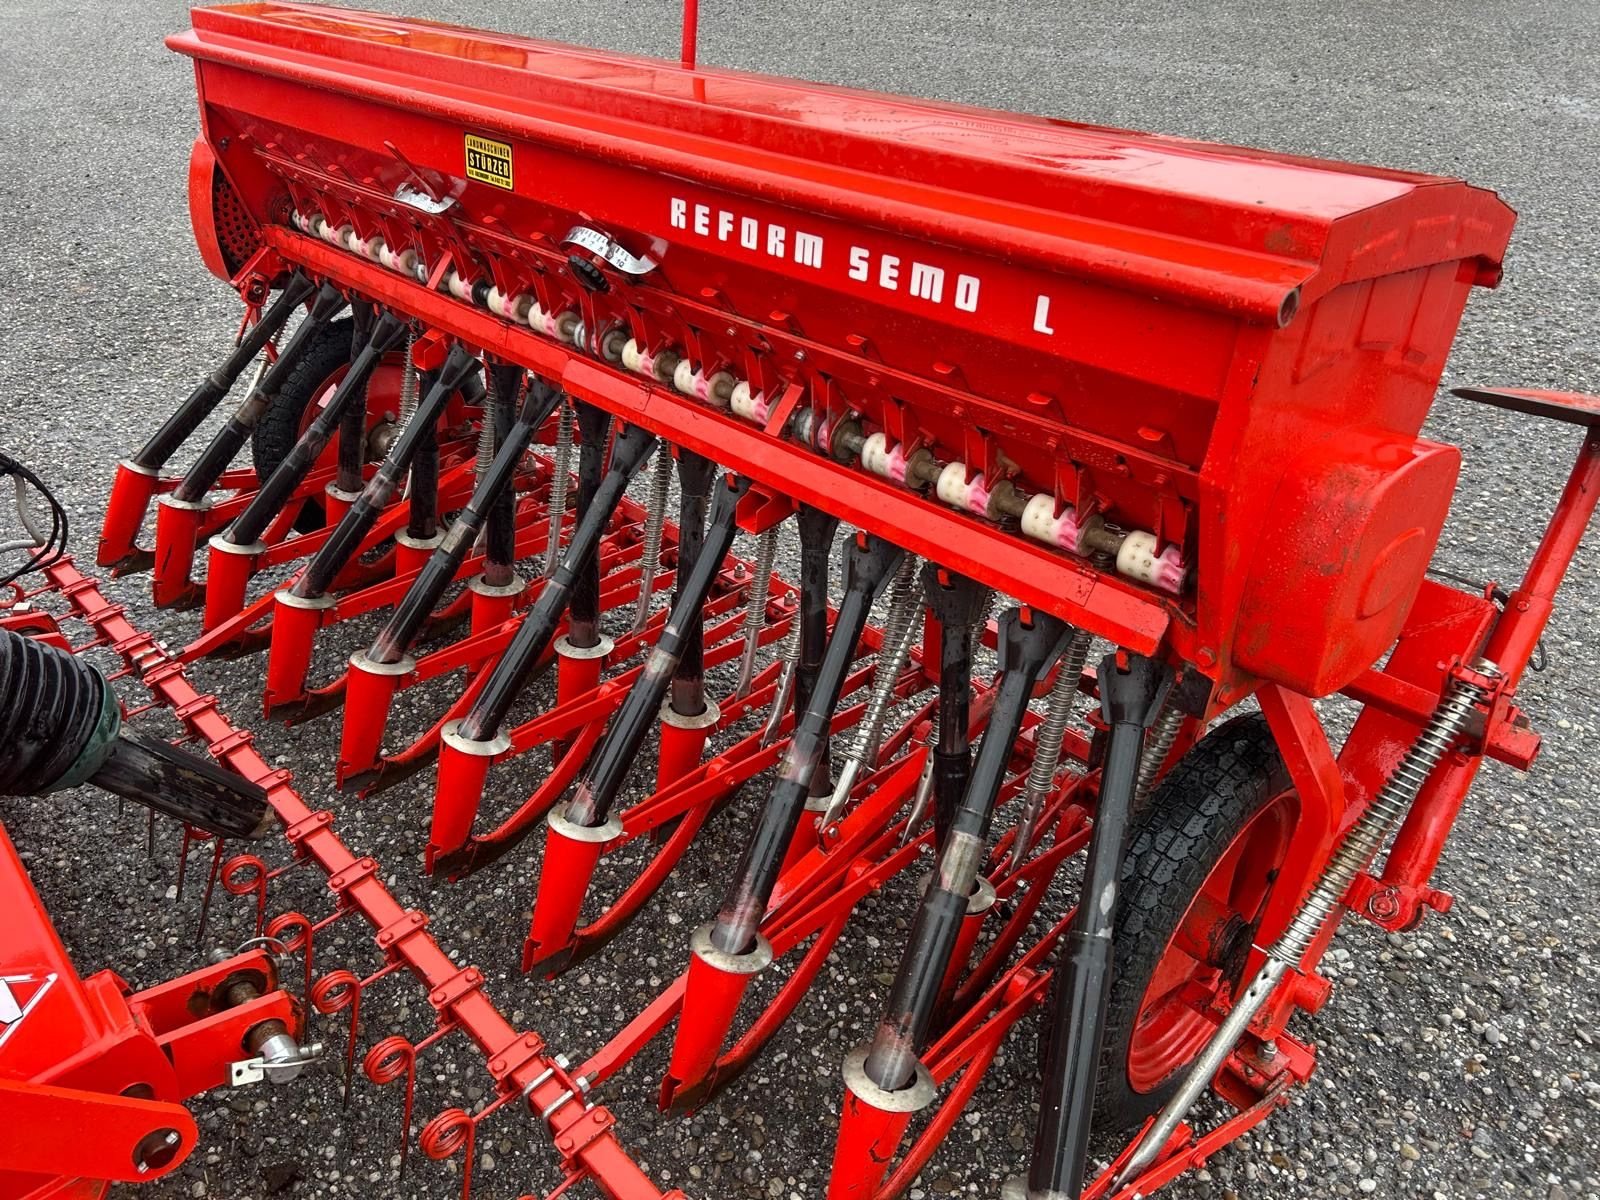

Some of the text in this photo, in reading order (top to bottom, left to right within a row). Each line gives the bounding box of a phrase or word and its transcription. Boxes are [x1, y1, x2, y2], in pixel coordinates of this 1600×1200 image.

[467, 137, 510, 158] LANDMASCHINEN
[470, 152, 509, 177] STÜRZER
[670, 197, 1054, 335] REFORM SEMO L
